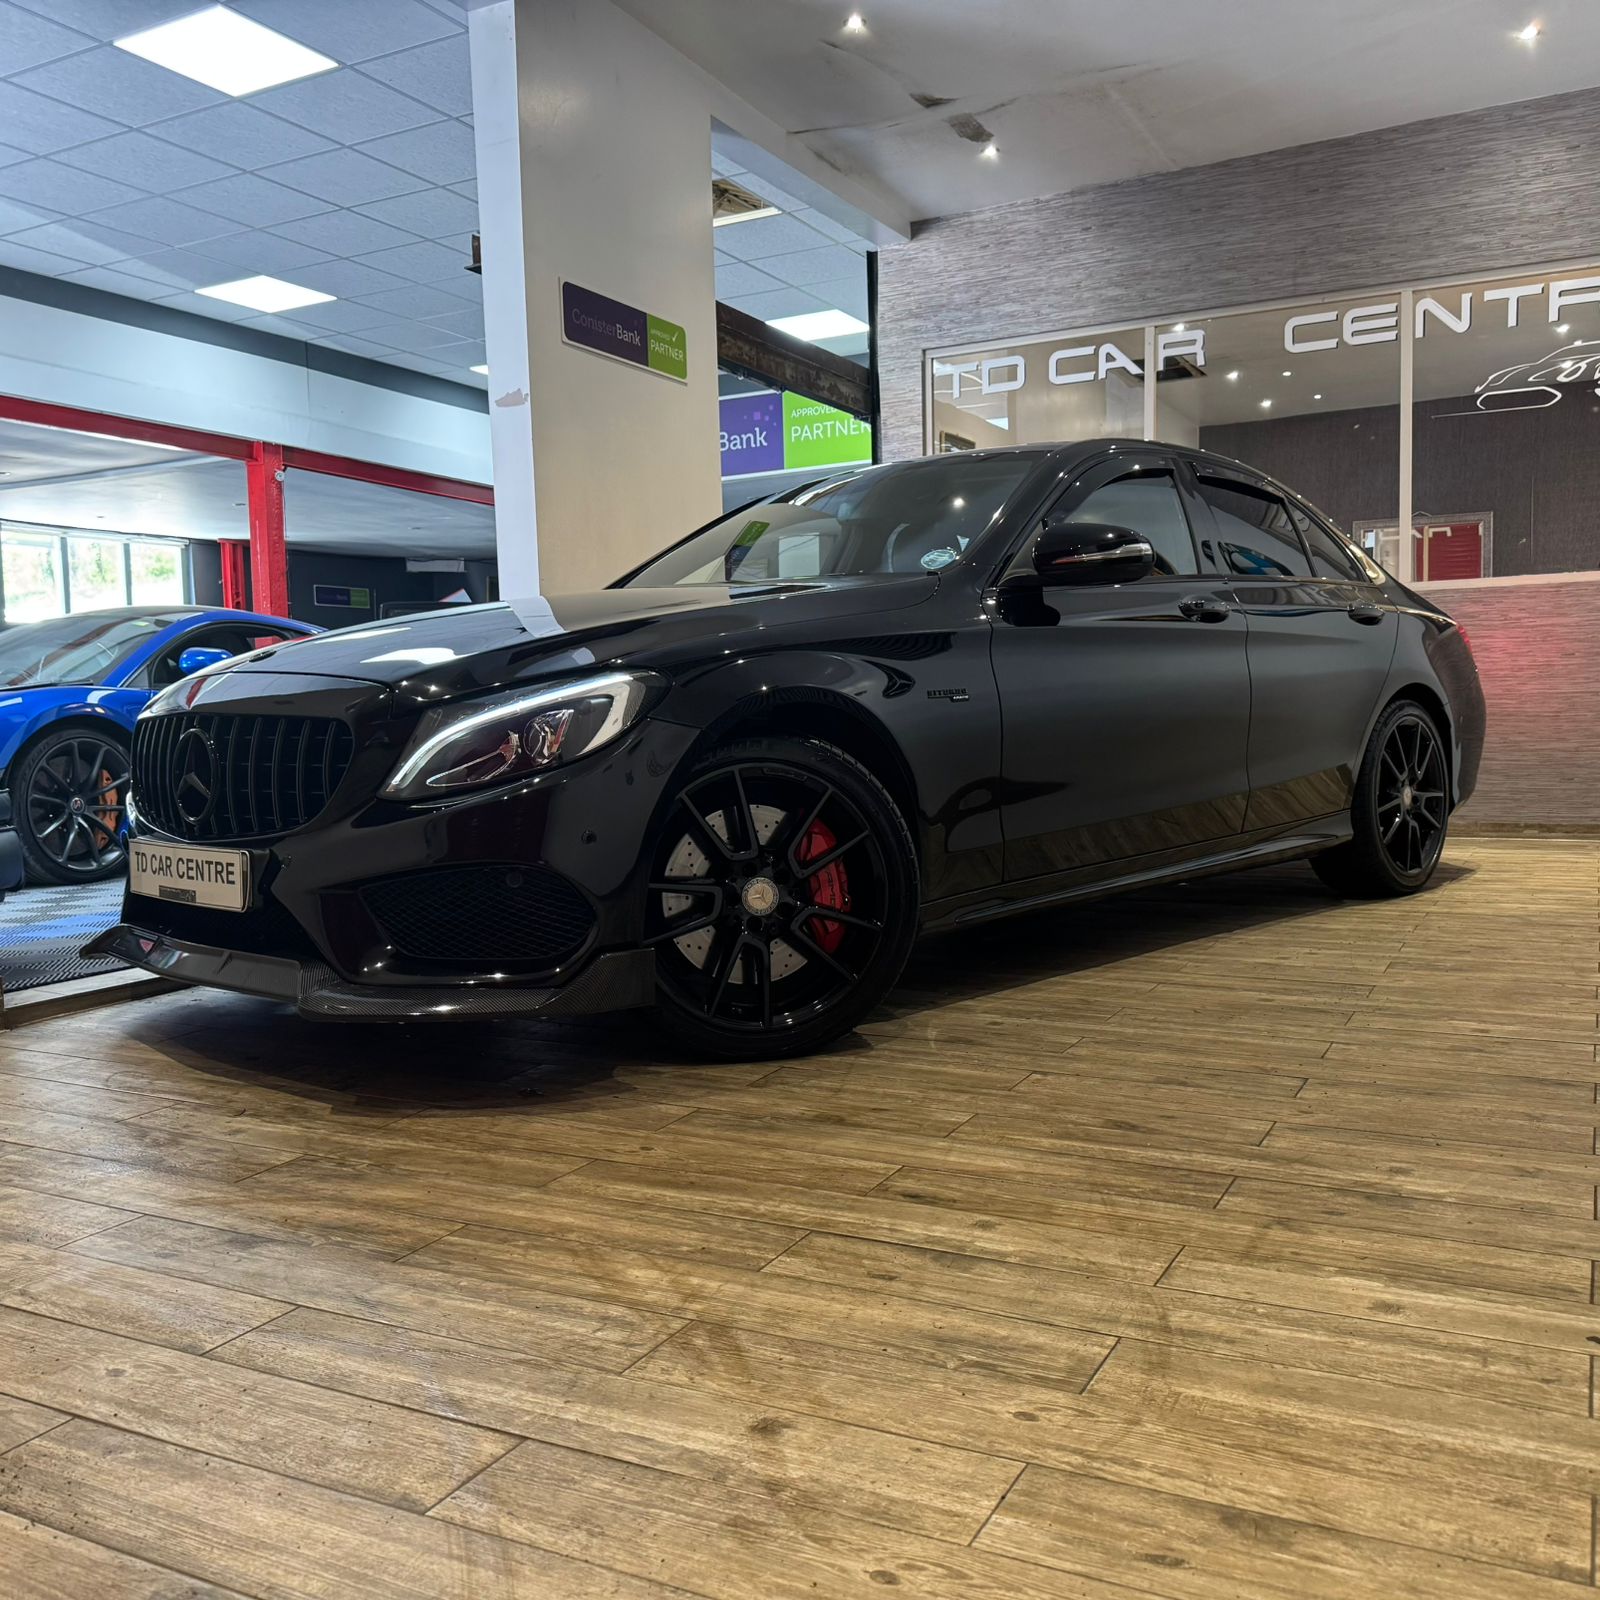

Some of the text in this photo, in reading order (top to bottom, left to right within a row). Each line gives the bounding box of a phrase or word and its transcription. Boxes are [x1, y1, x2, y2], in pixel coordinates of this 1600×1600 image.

[571, 307, 641, 347] ConisterBank
[650, 339, 684, 361] PARTNER
[935, 354, 1025, 399] TD
[1049, 329, 1206, 385] CAR
[720, 427, 768, 452] Bank
[135, 851, 236, 885] TD CAR CENTRE
